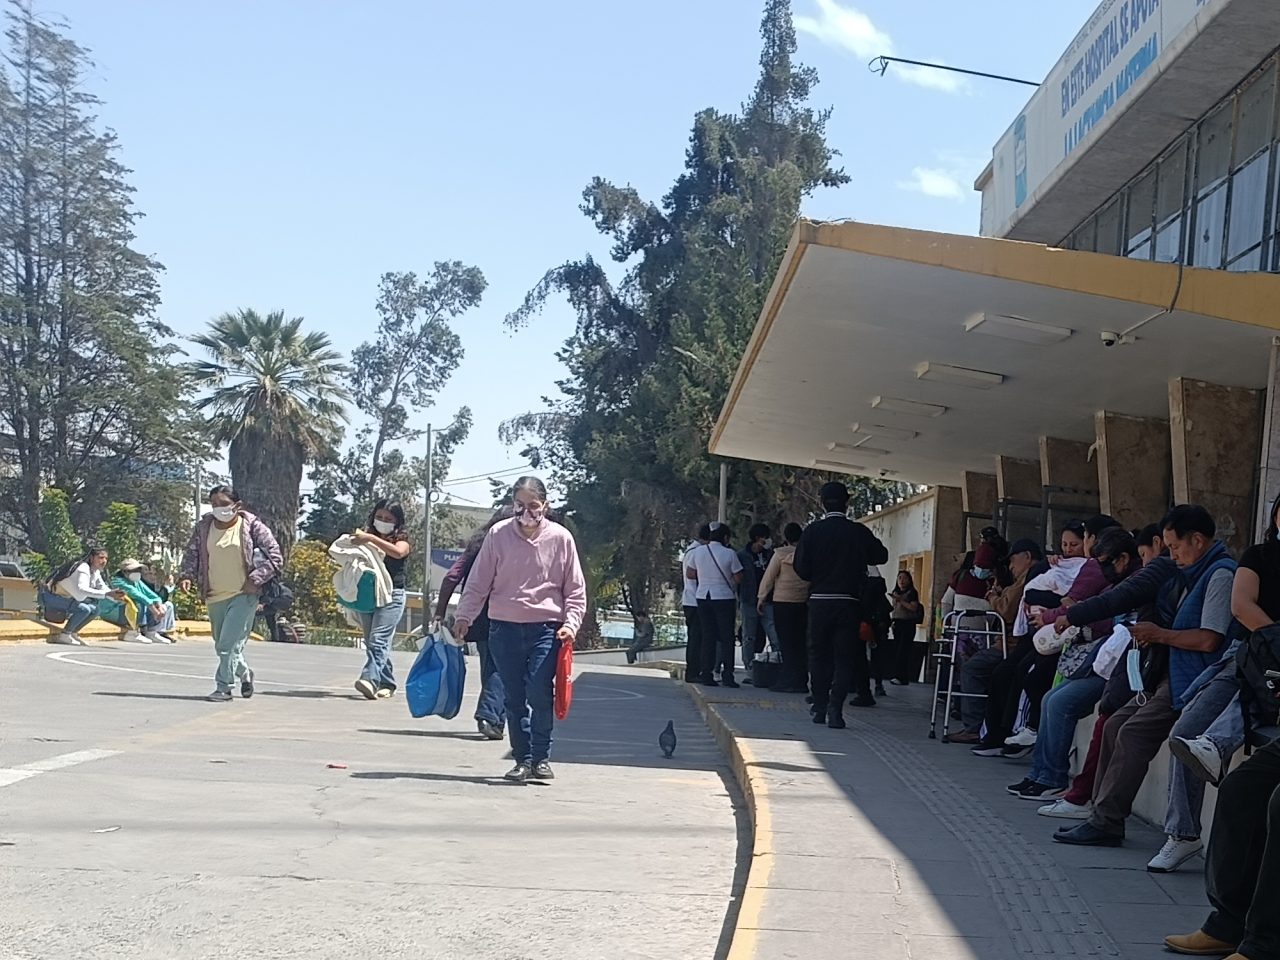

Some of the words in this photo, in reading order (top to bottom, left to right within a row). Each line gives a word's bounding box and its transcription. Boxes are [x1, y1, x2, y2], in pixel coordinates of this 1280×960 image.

[1070, 57, 1085, 108] ESTE
[1085, 15, 1120, 91] HOSPITAL
[1130, 0, 1160, 38] APO
